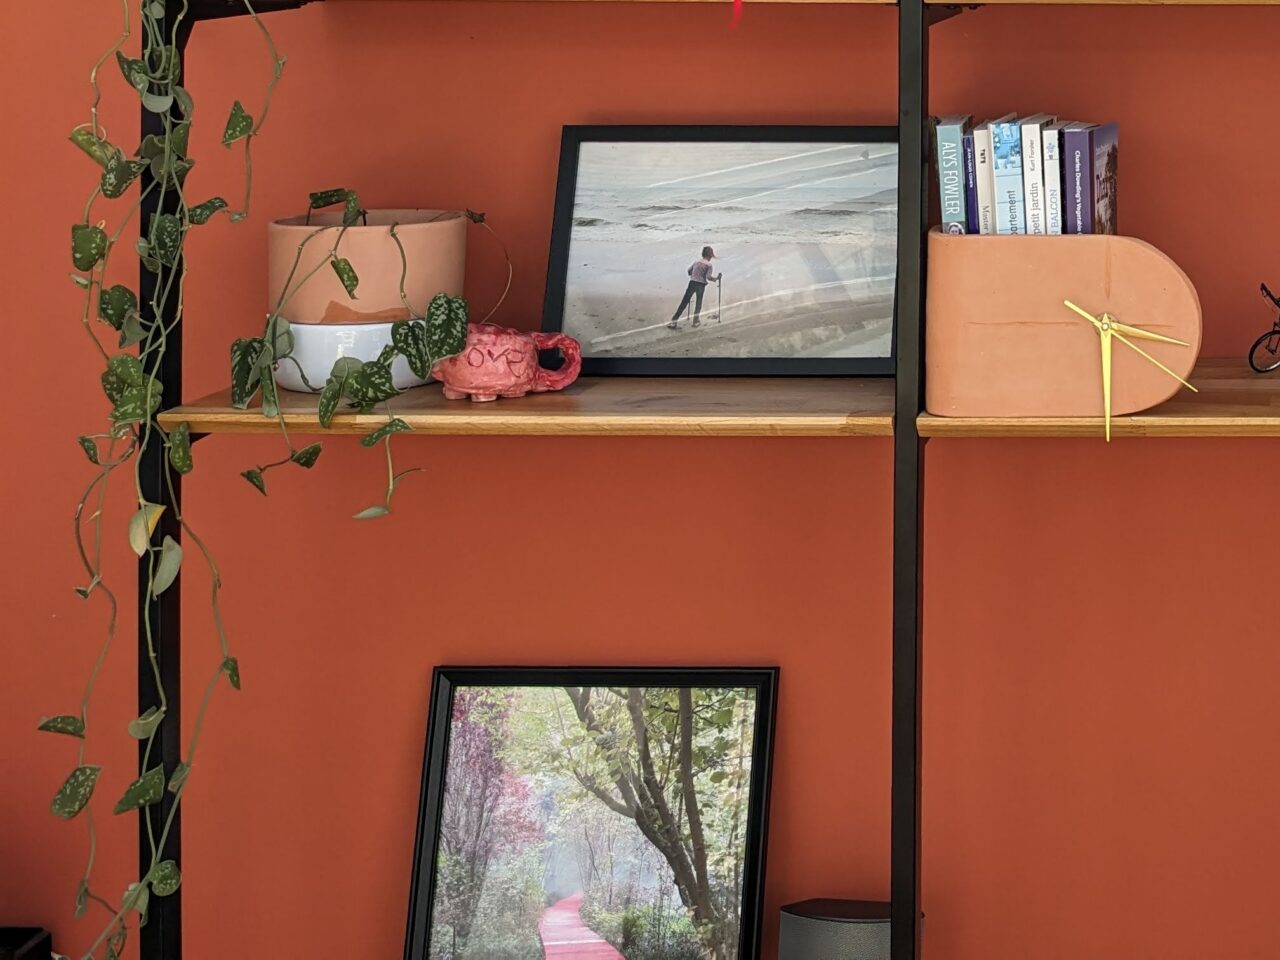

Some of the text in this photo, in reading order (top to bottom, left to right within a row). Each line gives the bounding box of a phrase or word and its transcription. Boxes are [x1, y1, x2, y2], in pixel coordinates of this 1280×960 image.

[942, 142, 960, 214] ALYS FOWLER
[1029, 182, 1042, 235] petit jardin
[1049, 189, 1059, 228] BALCON
